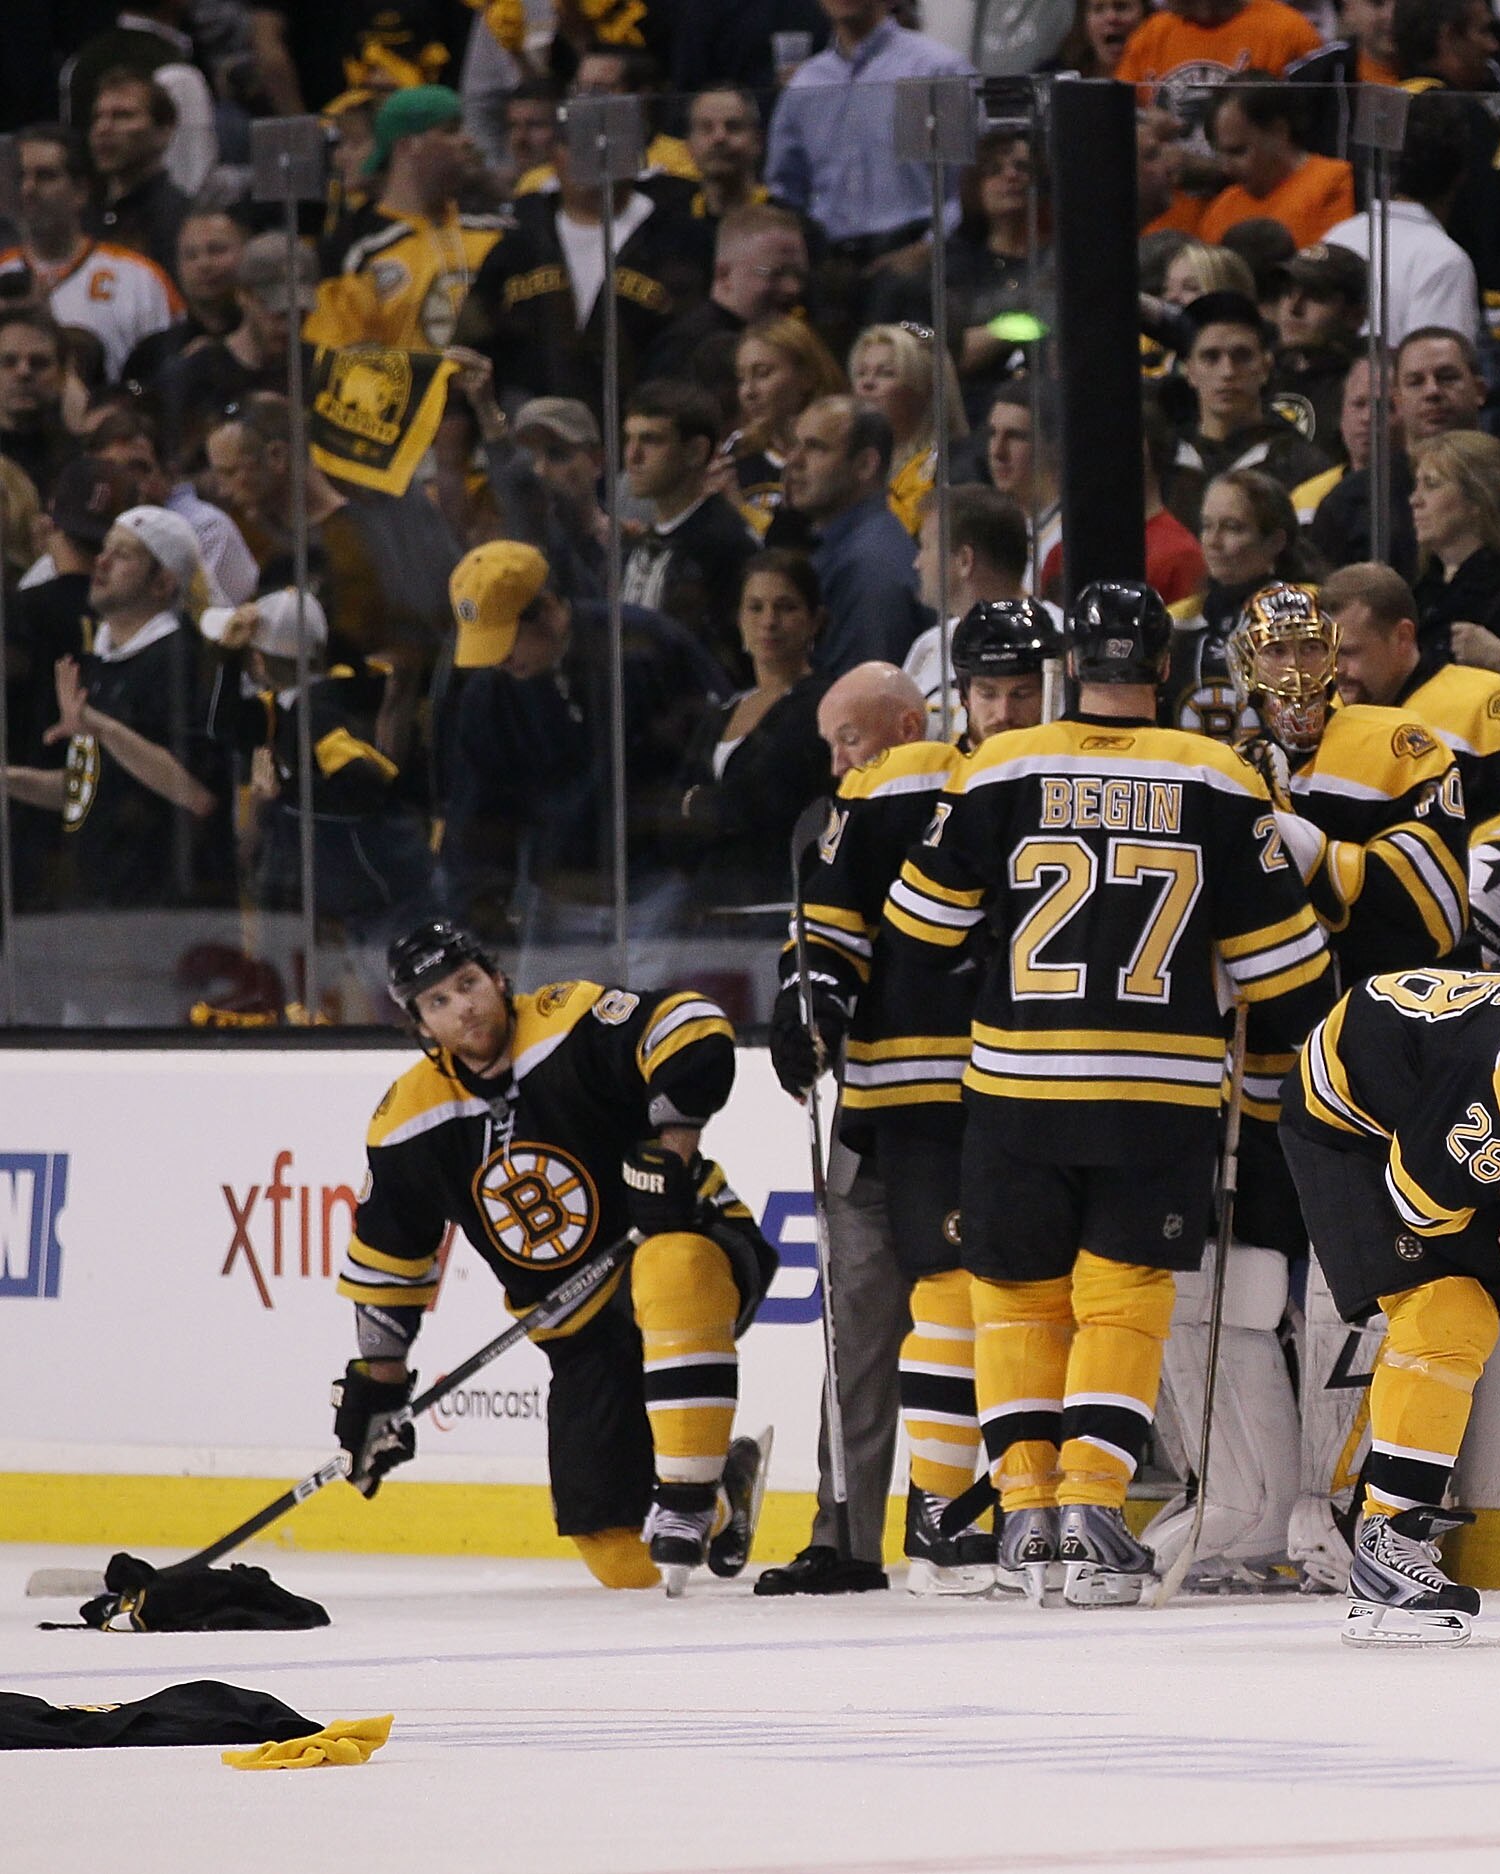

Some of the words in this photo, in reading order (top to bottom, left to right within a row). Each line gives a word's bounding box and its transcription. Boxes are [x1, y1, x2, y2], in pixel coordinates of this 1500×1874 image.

[89, 270, 115, 301] C
[1105, 638, 1135, 659] 27
[1040, 777, 1183, 834] BEGIN
[1253, 813, 1289, 873] 2
[1008, 835, 1204, 1004] 27
[221, 1150, 458, 1311] xfin
[497, 1171, 570, 1249] B
[439, 1387, 543, 1419] comcast
[1028, 1540, 1045, 1555] 27
[1063, 1539, 1079, 1554] 27
